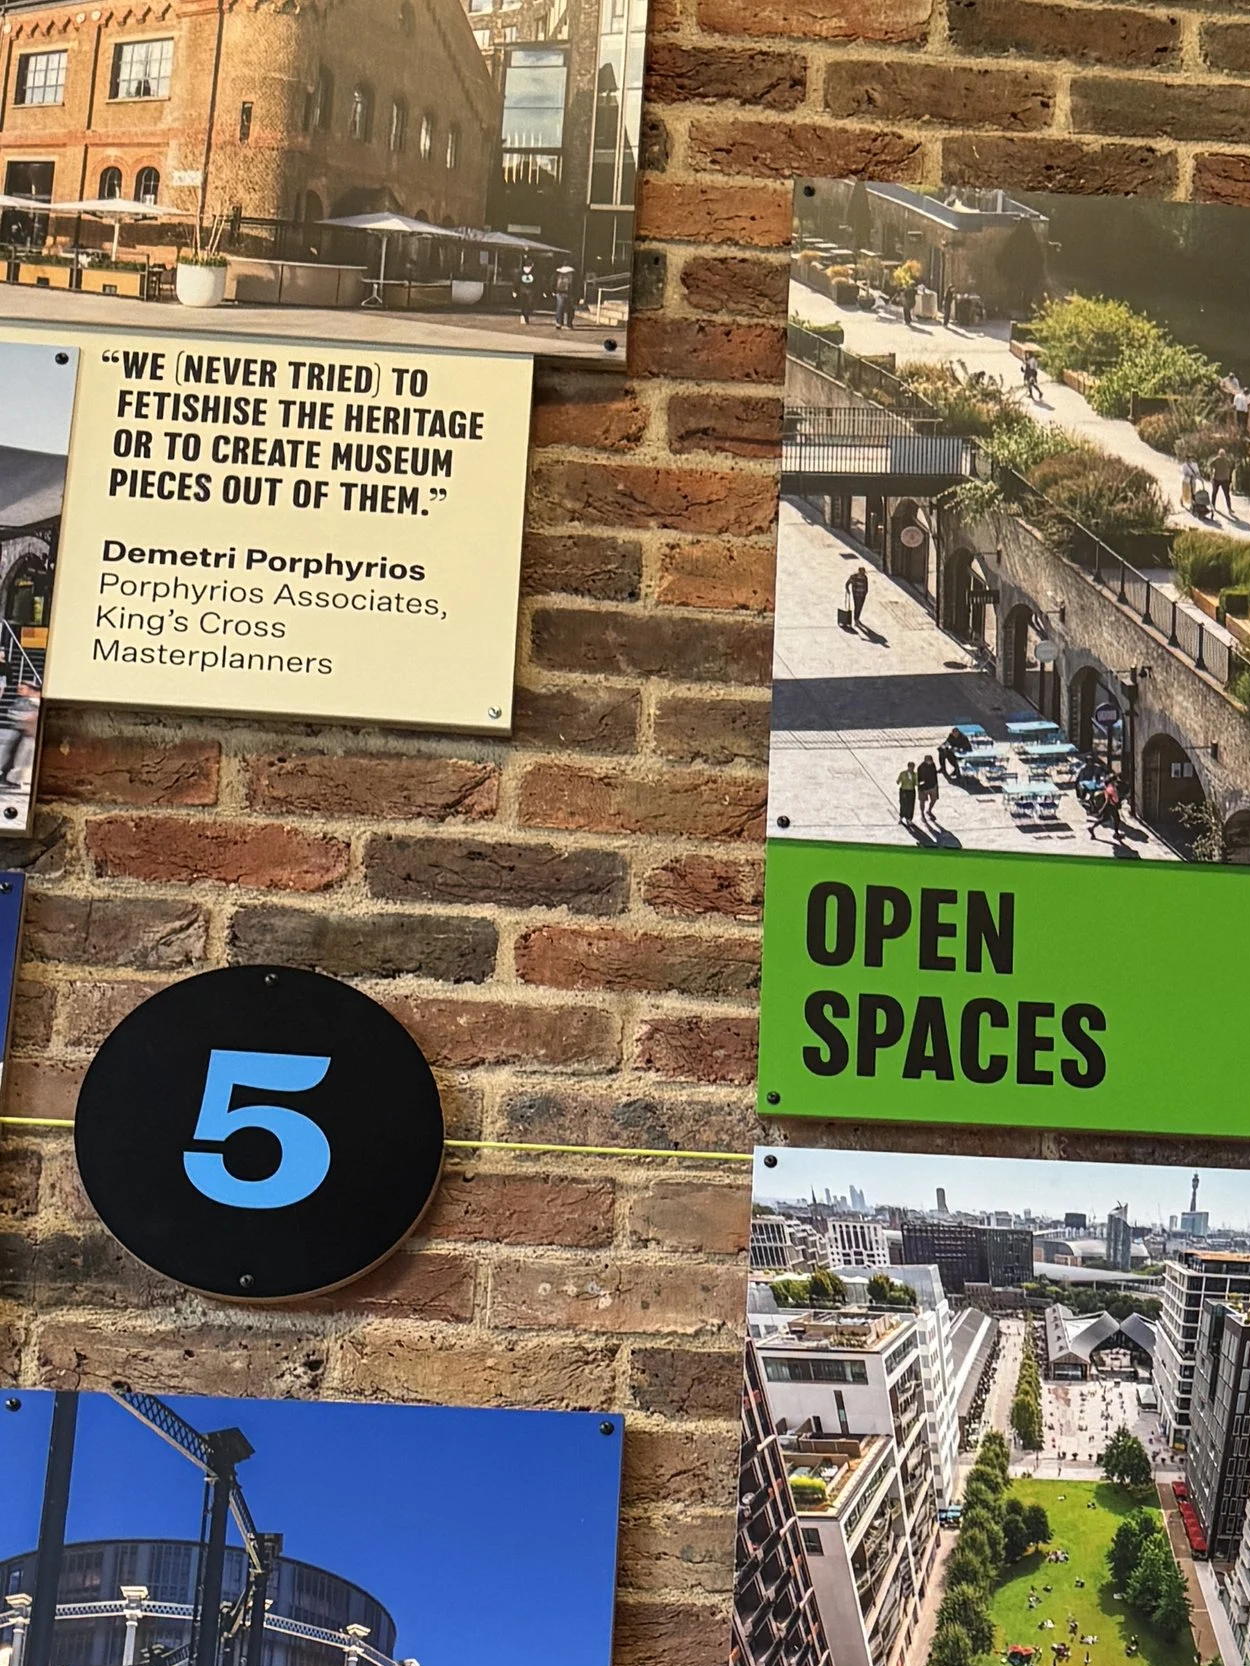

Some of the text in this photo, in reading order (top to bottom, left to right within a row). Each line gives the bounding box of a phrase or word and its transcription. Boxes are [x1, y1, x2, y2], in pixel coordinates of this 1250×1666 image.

[101, 349, 166, 381] “WE
[391, 367, 429, 398] TO
[117, 389, 485, 441] FETISHISE THE HERITAGE
[113, 428, 453, 478] OR TO CREATE MUSEUM
[108, 467, 448, 517] PIECES OUT OF THEM.”
[102, 539, 426, 582] Demetri Porphyrios
[96, 604, 286, 639] King’s Cross
[99, 572, 447, 621] Porphyrios Associates,
[92, 638, 333, 675] Masterplanners
[806, 880, 1015, 975] OPEN
[802, 989, 1107, 1089] SPACES
[183, 1048, 332, 1210] 5
